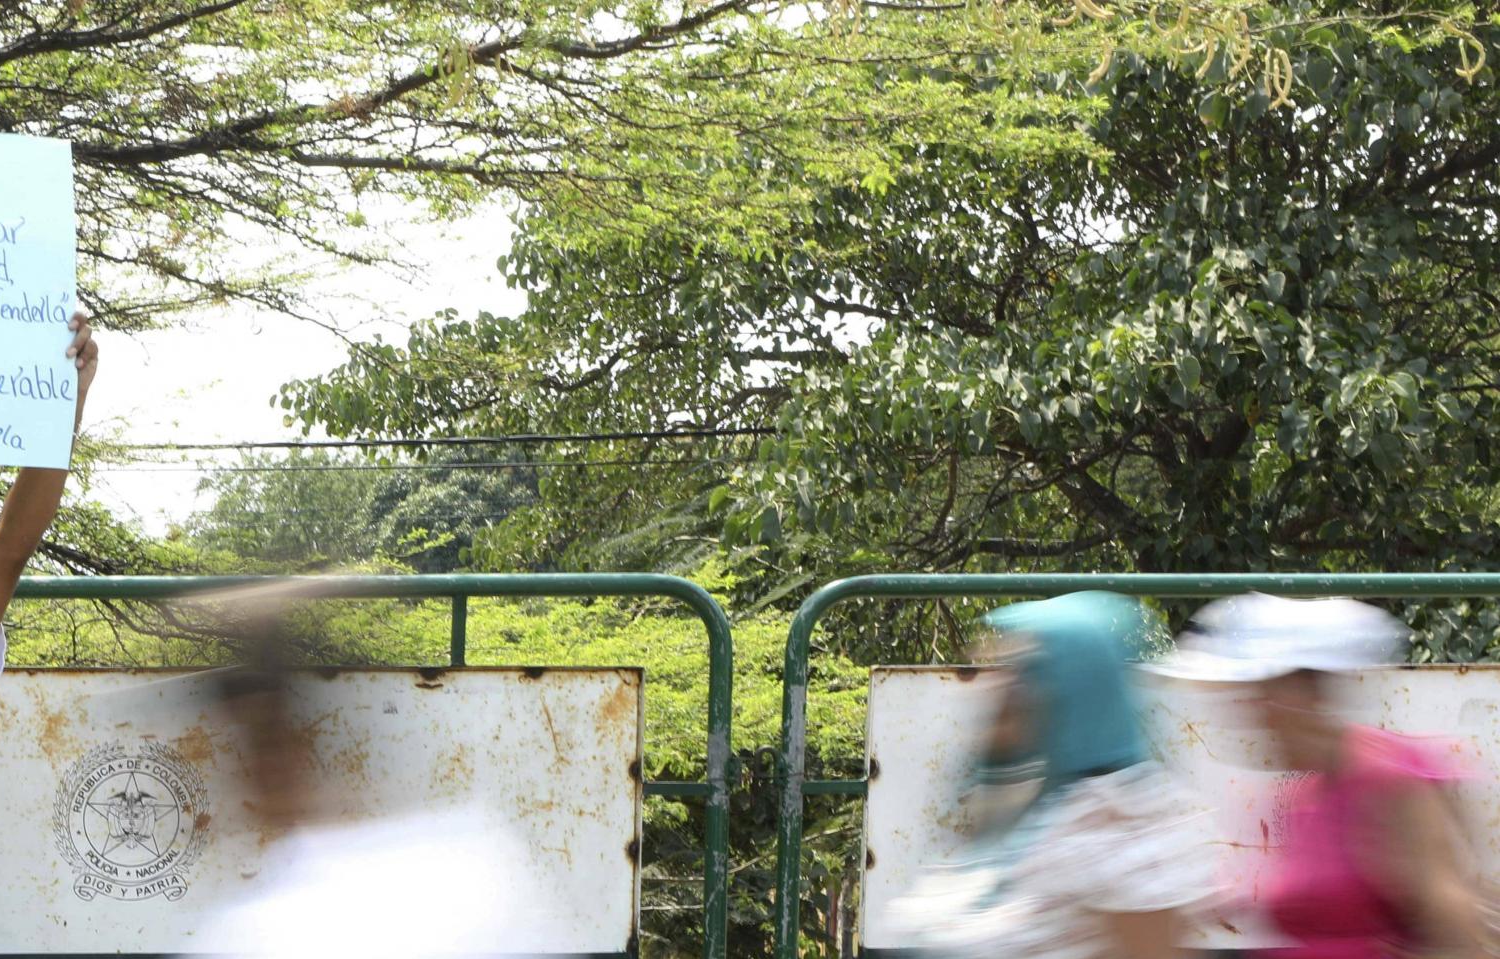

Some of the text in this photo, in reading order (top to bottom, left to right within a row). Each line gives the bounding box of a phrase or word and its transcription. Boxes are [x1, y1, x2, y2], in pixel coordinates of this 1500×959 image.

[73, 765, 116, 814] REPUBLICA
[126, 760, 141, 770] DE
[85, 850, 179, 878] POLICIA NACIONAL
[83, 875, 180, 897] DIOS Y PATRIA
